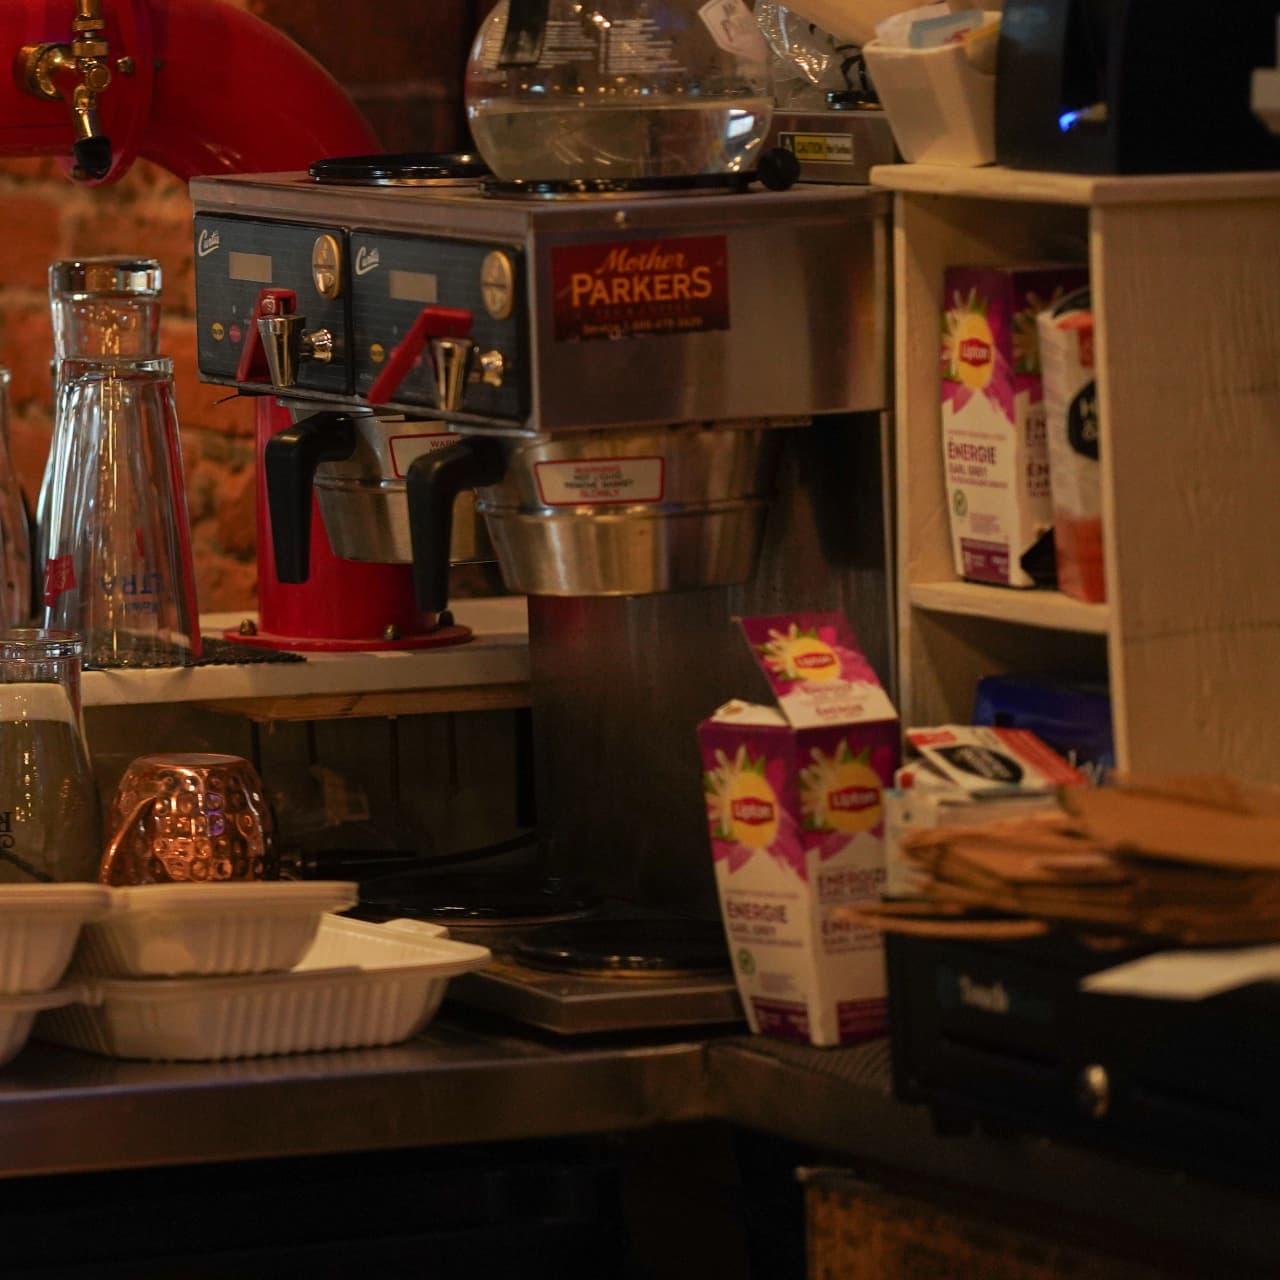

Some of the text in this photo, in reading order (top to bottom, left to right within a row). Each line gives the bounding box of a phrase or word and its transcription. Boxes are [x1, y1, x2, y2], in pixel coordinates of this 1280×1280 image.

[198, 228, 220, 257] Curtis
[355, 246, 380, 276] Curtis
[595, 245, 688, 274] Mother
[570, 266, 713, 307] PARKERS
[961, 342, 989, 361] Lipton
[948, 437, 997, 465] ÉNERGIE
